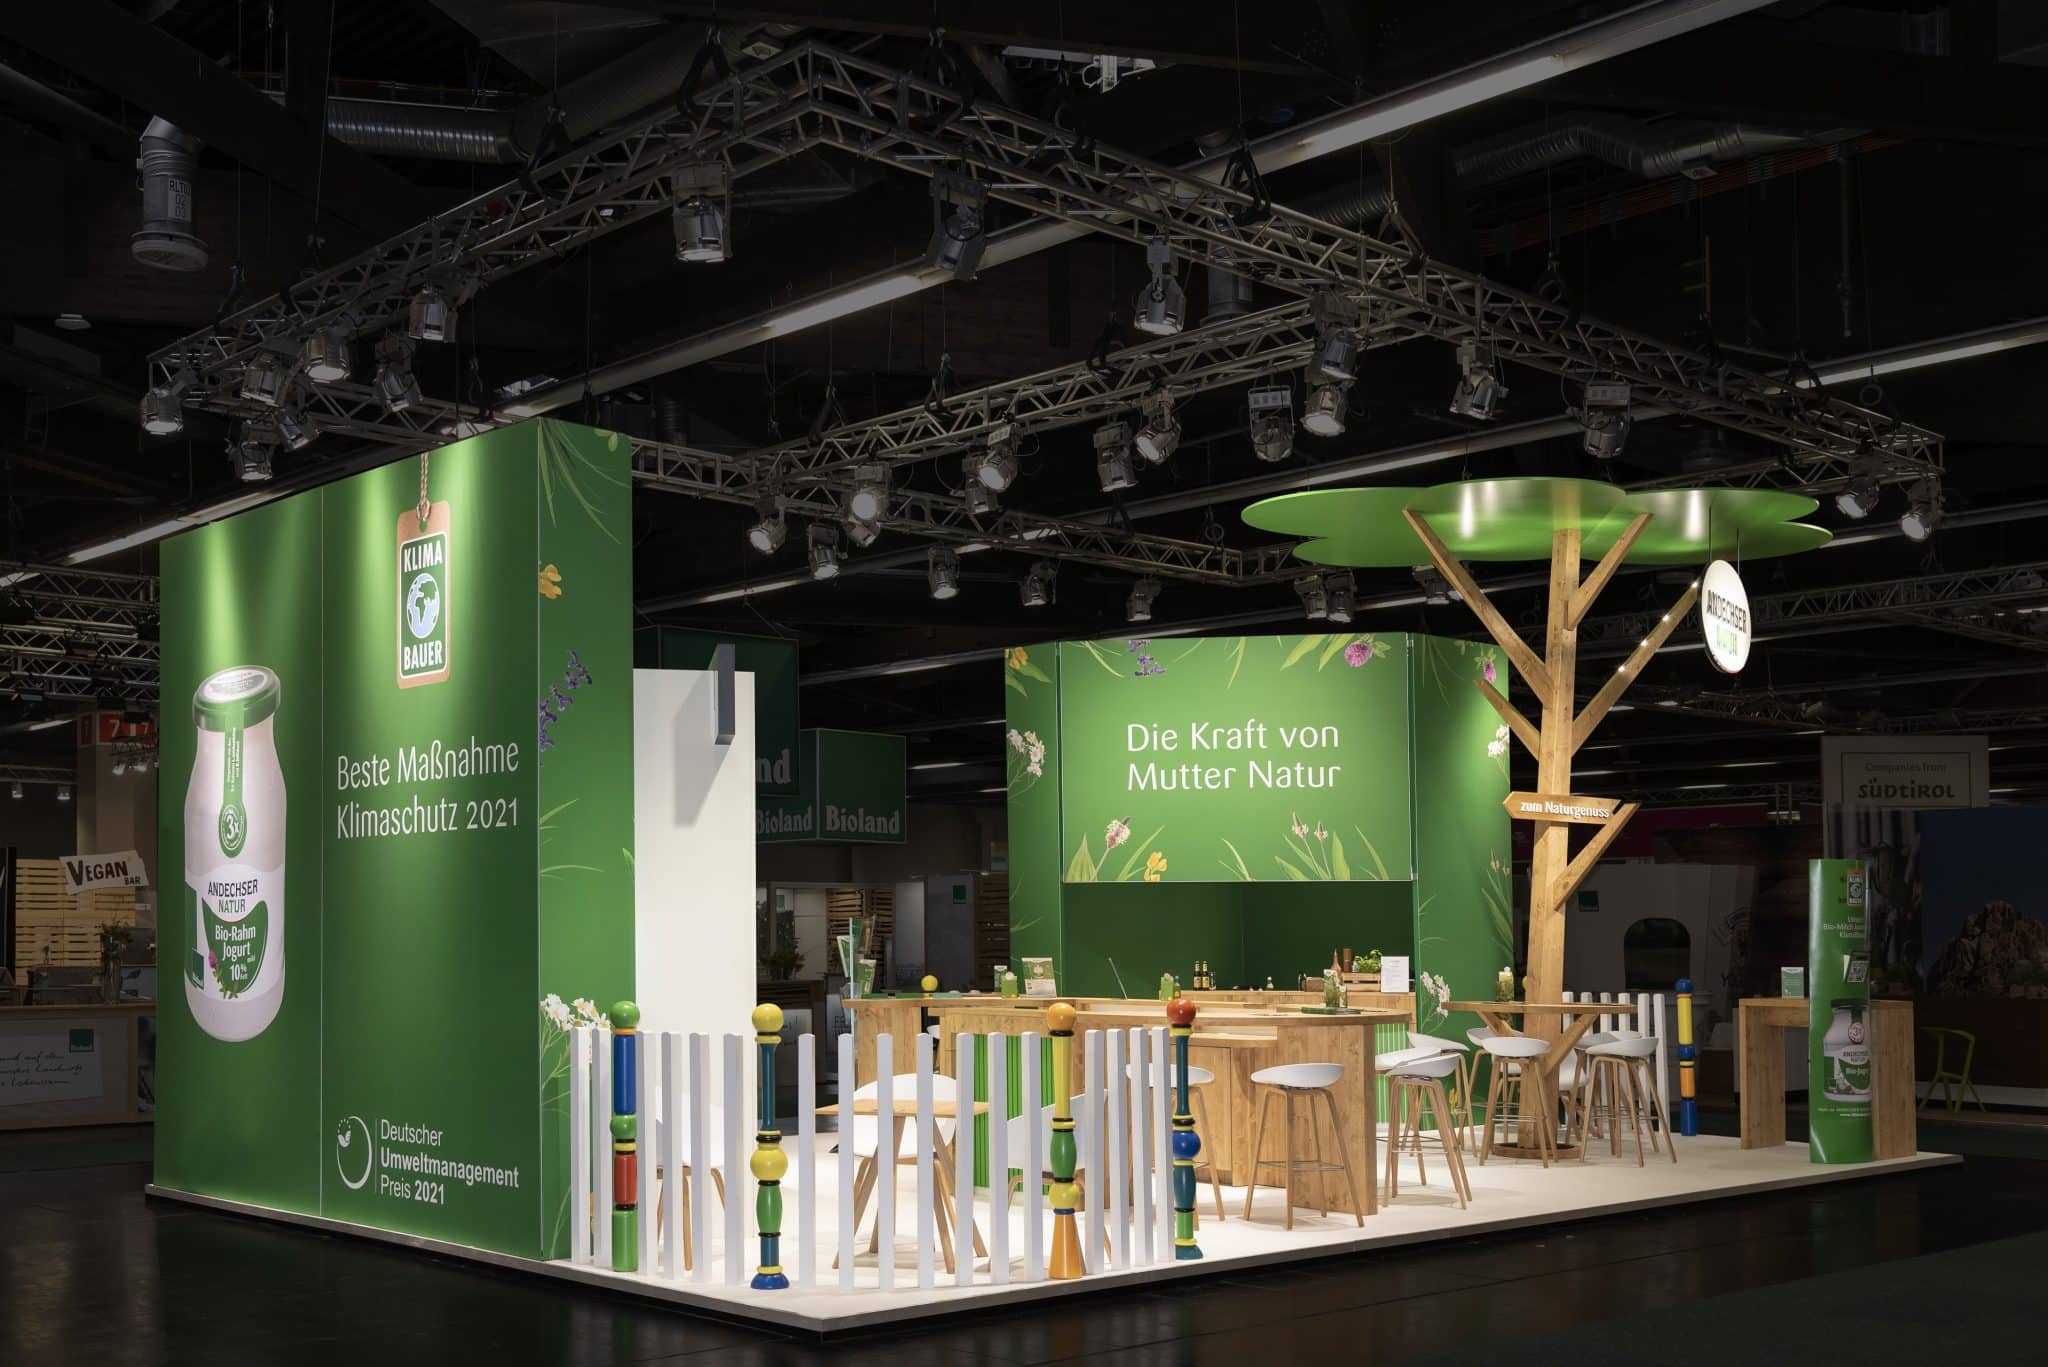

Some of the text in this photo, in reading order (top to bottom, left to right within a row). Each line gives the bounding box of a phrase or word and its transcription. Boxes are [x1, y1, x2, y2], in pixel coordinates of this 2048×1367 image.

[403, 540, 443, 573] KLIMA
[1706, 589, 1747, 634] ANDECHSER
[403, 640, 443, 670] BAUER
[1127, 718, 1339, 752] Die Kraft von
[337, 736, 519, 790] Beste Maßnahme
[1127, 760, 1341, 791] Mutter Natur
[337, 795, 519, 839] Klimaschutz 2021
[824, 804, 900, 834] Bioland
[1520, 801, 1609, 818] zum Naturgenuss
[66, 860, 128, 886] VEGAN
[208, 879, 258, 897] ANDECHSER
[218, 899, 246, 913] NATUR
[215, 924, 256, 941] Bio-Rahm
[222, 941, 251, 962] Jogurt
[381, 1119, 443, 1147] Deutscher
[380, 1147, 519, 1188] Umweltmanagement
[381, 1175, 444, 1205] Preis 2021
